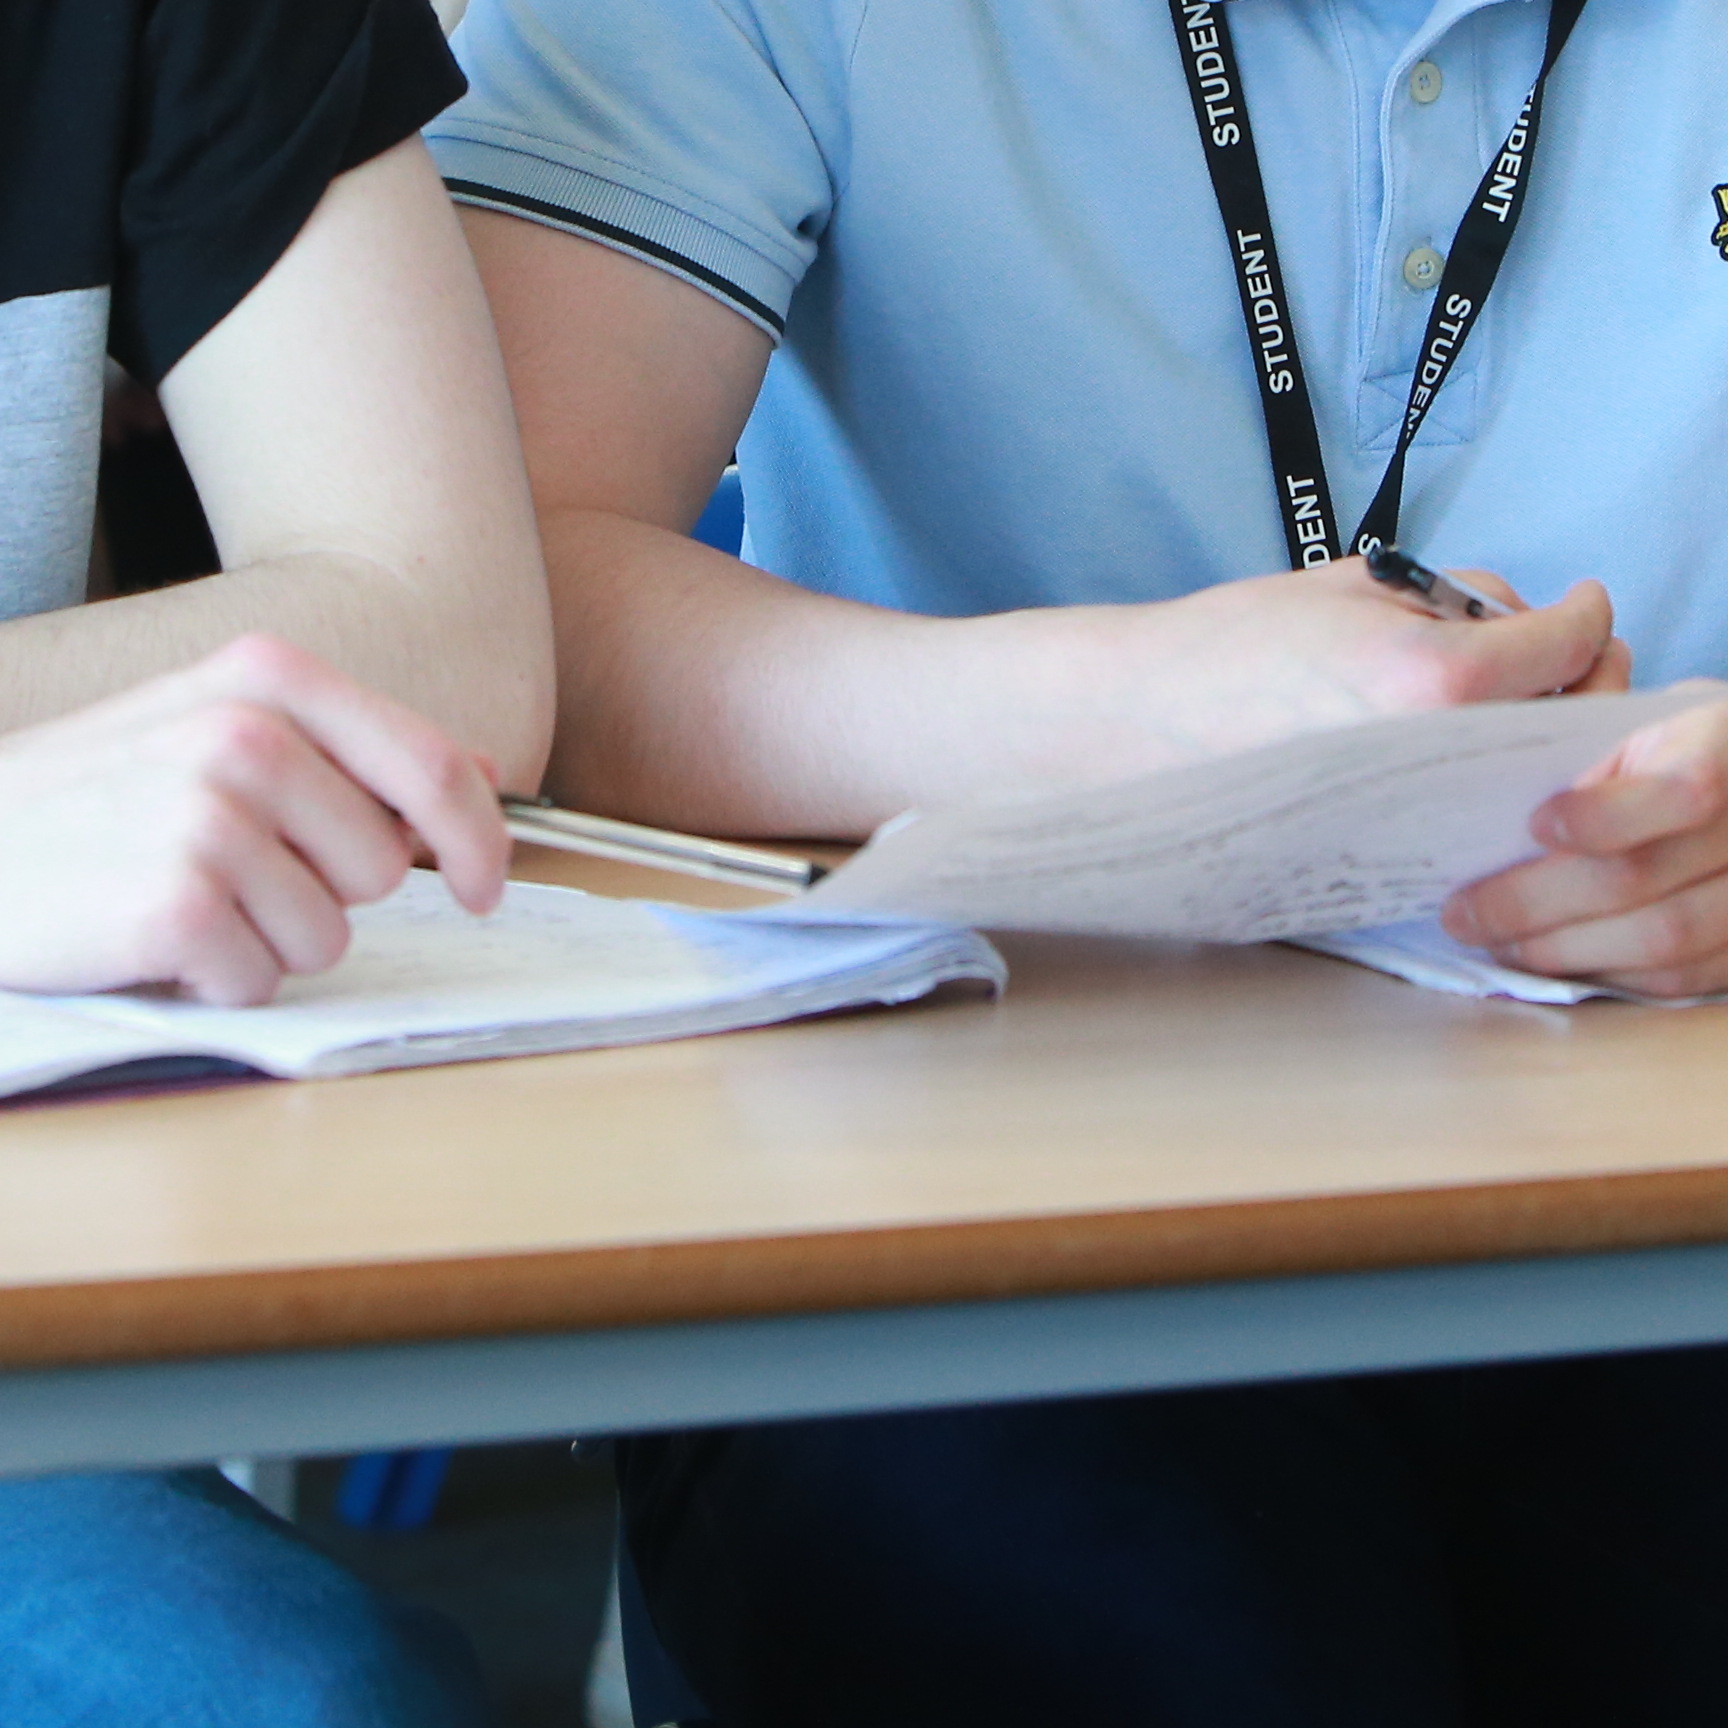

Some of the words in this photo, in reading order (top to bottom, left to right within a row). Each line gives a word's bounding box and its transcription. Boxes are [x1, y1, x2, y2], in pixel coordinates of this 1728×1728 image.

[1235, 229, 1295, 396] STUDENT
[1406, 293, 1472, 440] STUDEN
[1285, 474, 1332, 570] DENT
